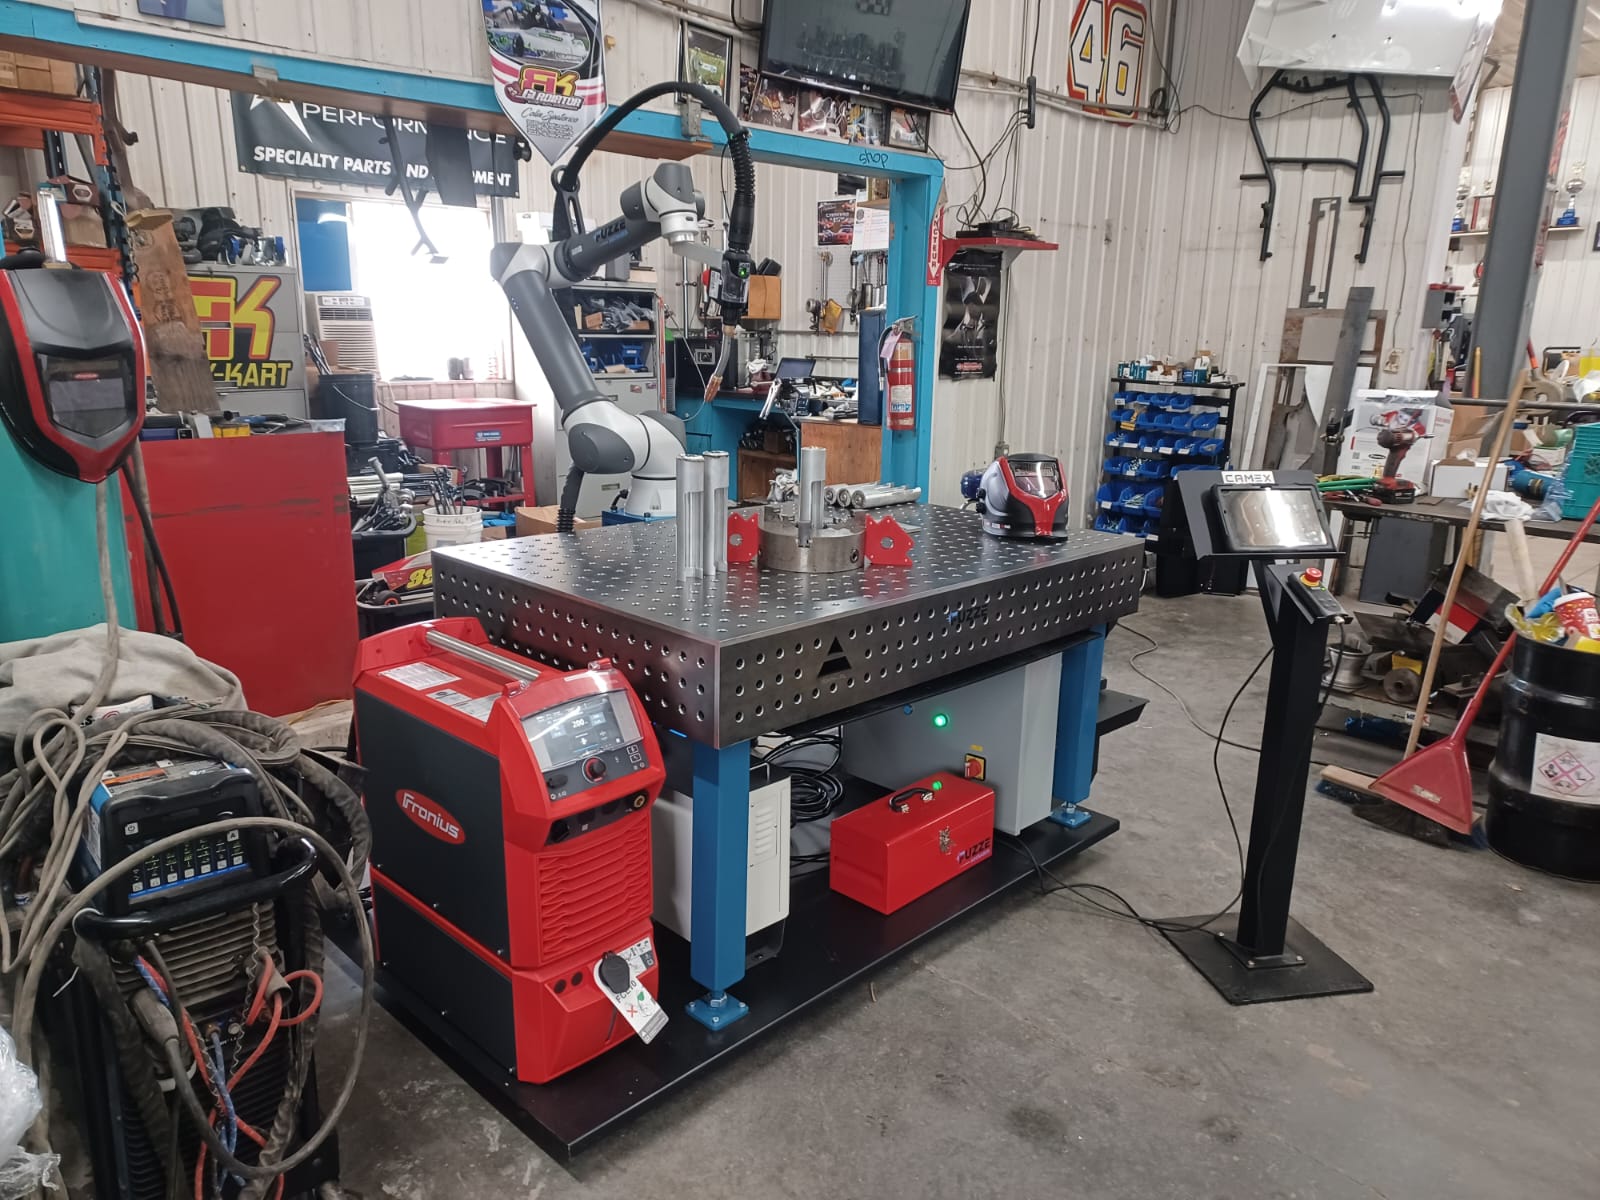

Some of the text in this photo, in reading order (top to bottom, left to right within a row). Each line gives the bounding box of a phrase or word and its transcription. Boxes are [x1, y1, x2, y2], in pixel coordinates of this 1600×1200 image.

[1068, 0, 1146, 117] 46
[253, 145, 340, 170] SPECIALTY
[343, 156, 392, 175] PARTS
[406, 163, 429, 179] ND
[859, 149, 889, 168] shop
[931, 214, 942, 268] NCTEUR
[1225, 474, 1272, 483] CAMEX
[402, 792, 460, 839] Fronius
